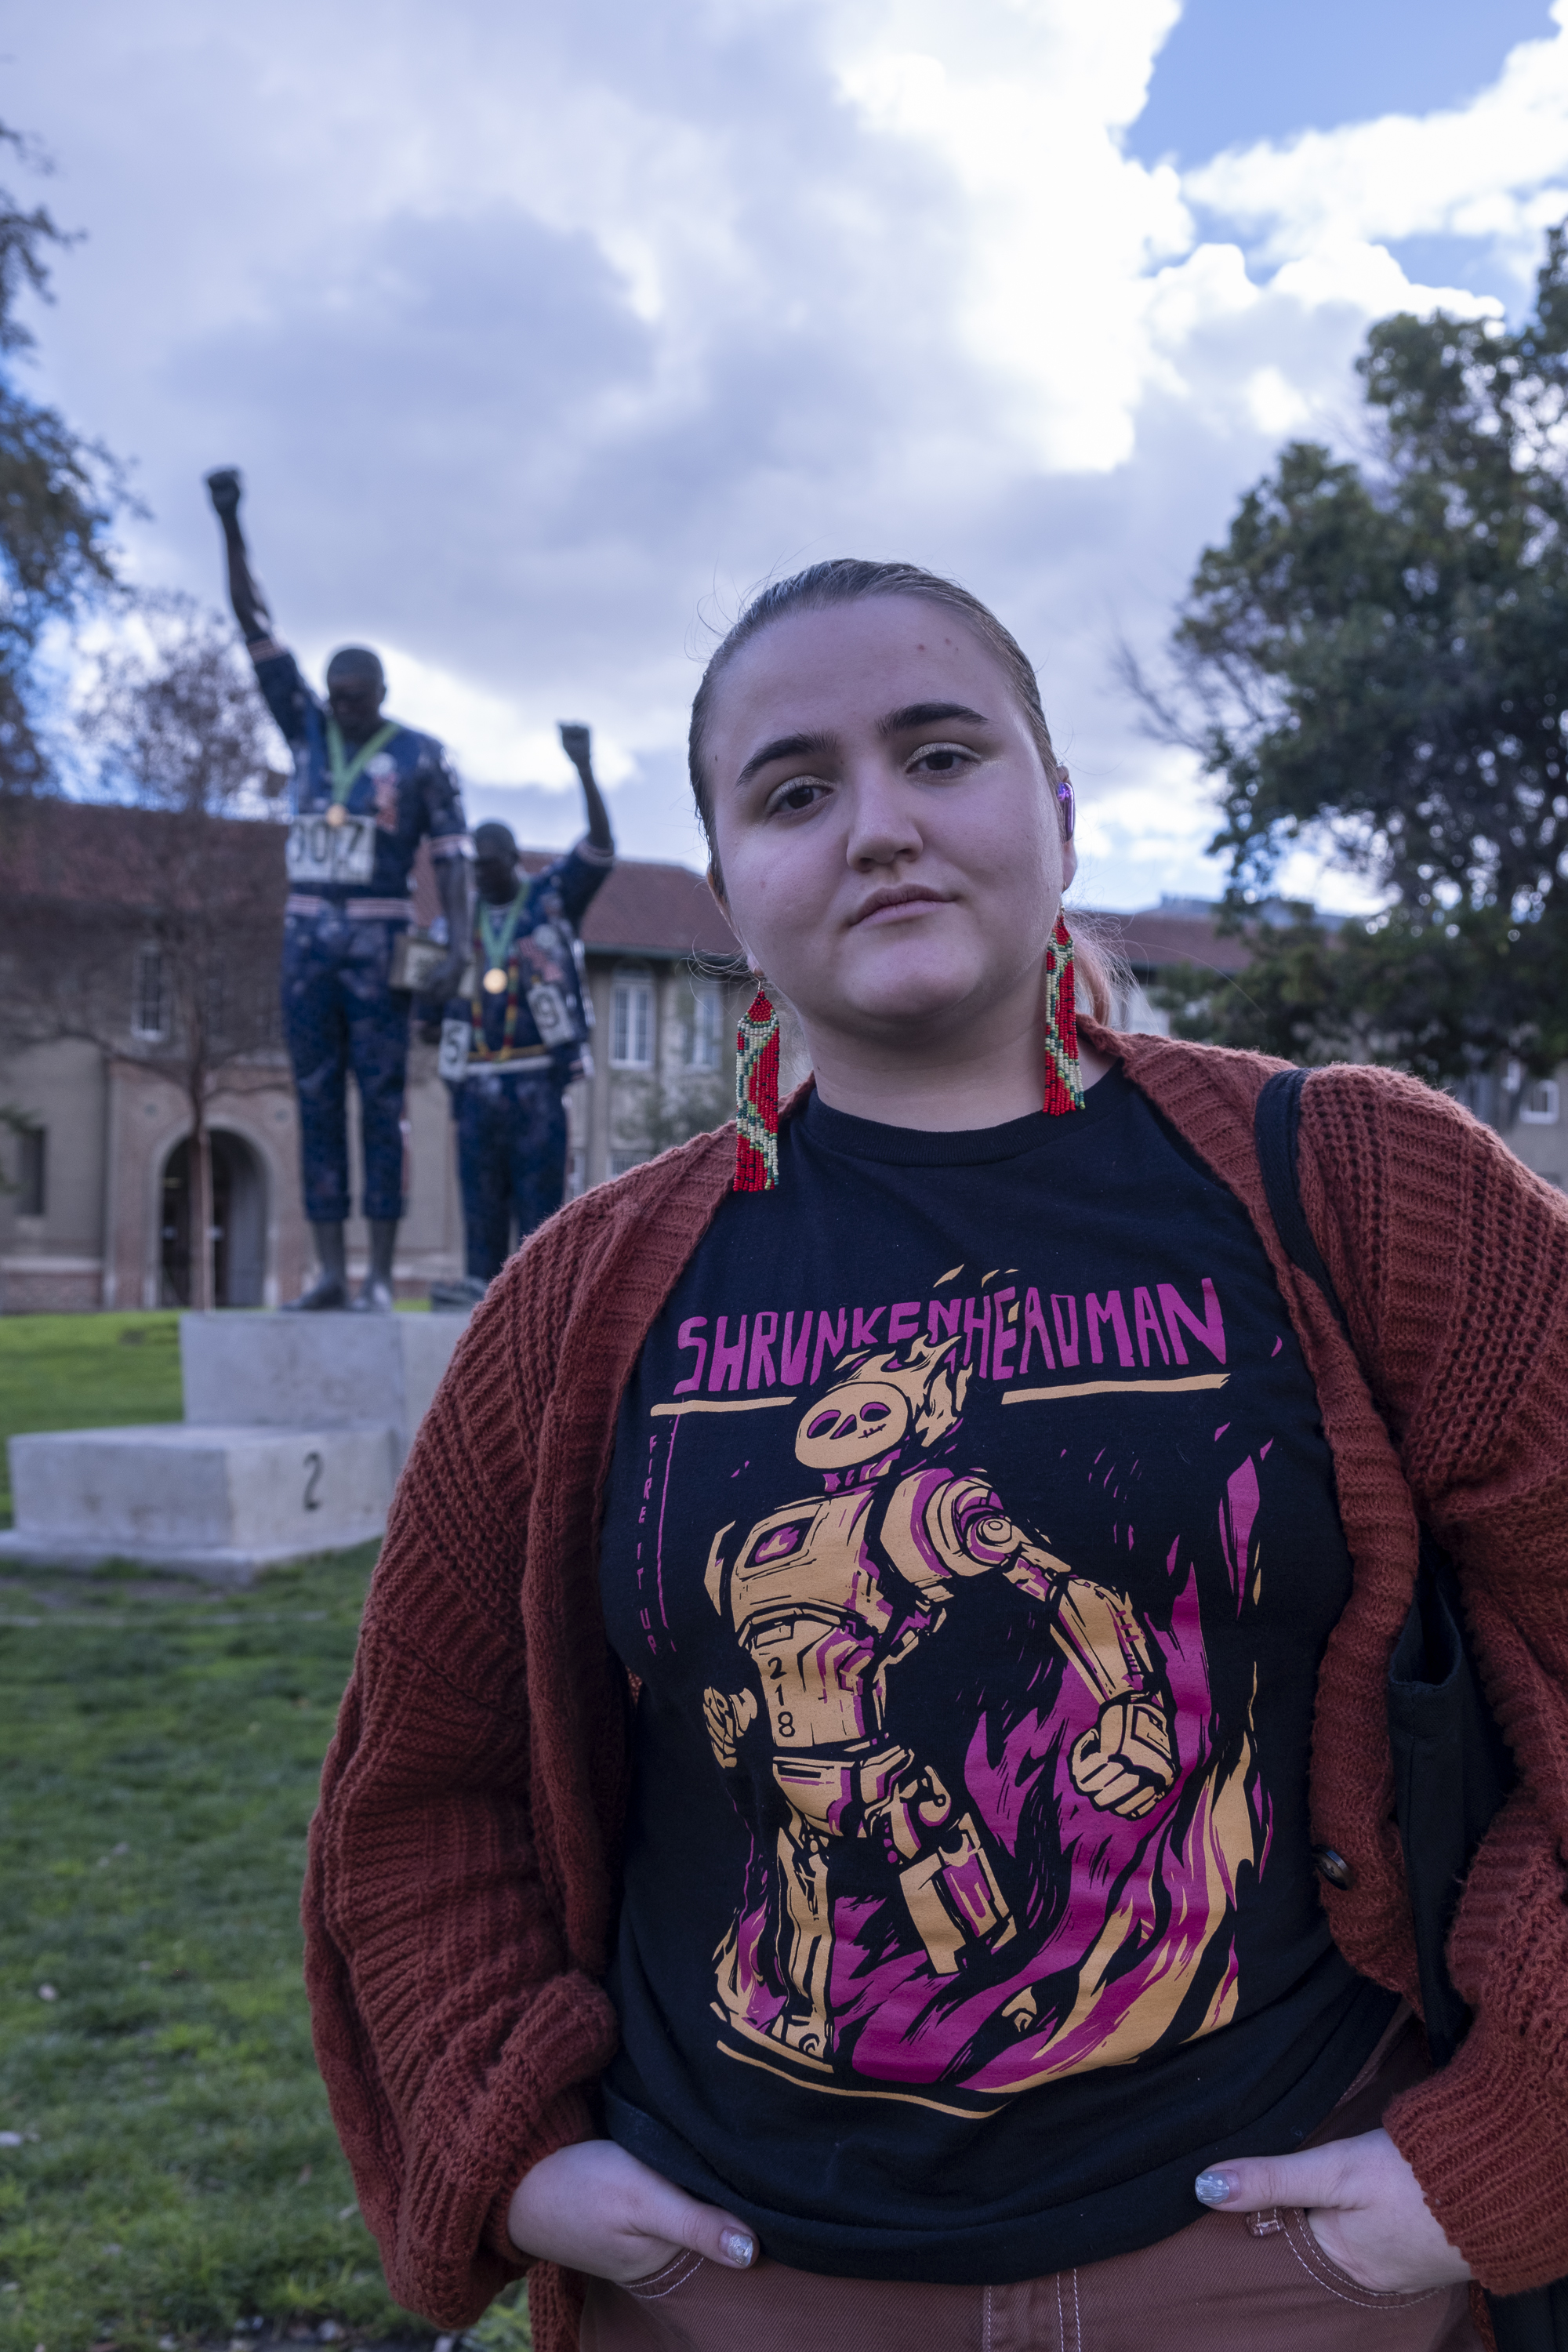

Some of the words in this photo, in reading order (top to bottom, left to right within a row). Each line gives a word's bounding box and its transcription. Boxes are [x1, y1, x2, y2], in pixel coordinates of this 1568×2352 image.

[303, 1451, 324, 1512] 2
[637, 1434, 658, 1523] FIRE
[637, 1541, 644, 1590] IT
[640, 1607, 657, 1655] UP
